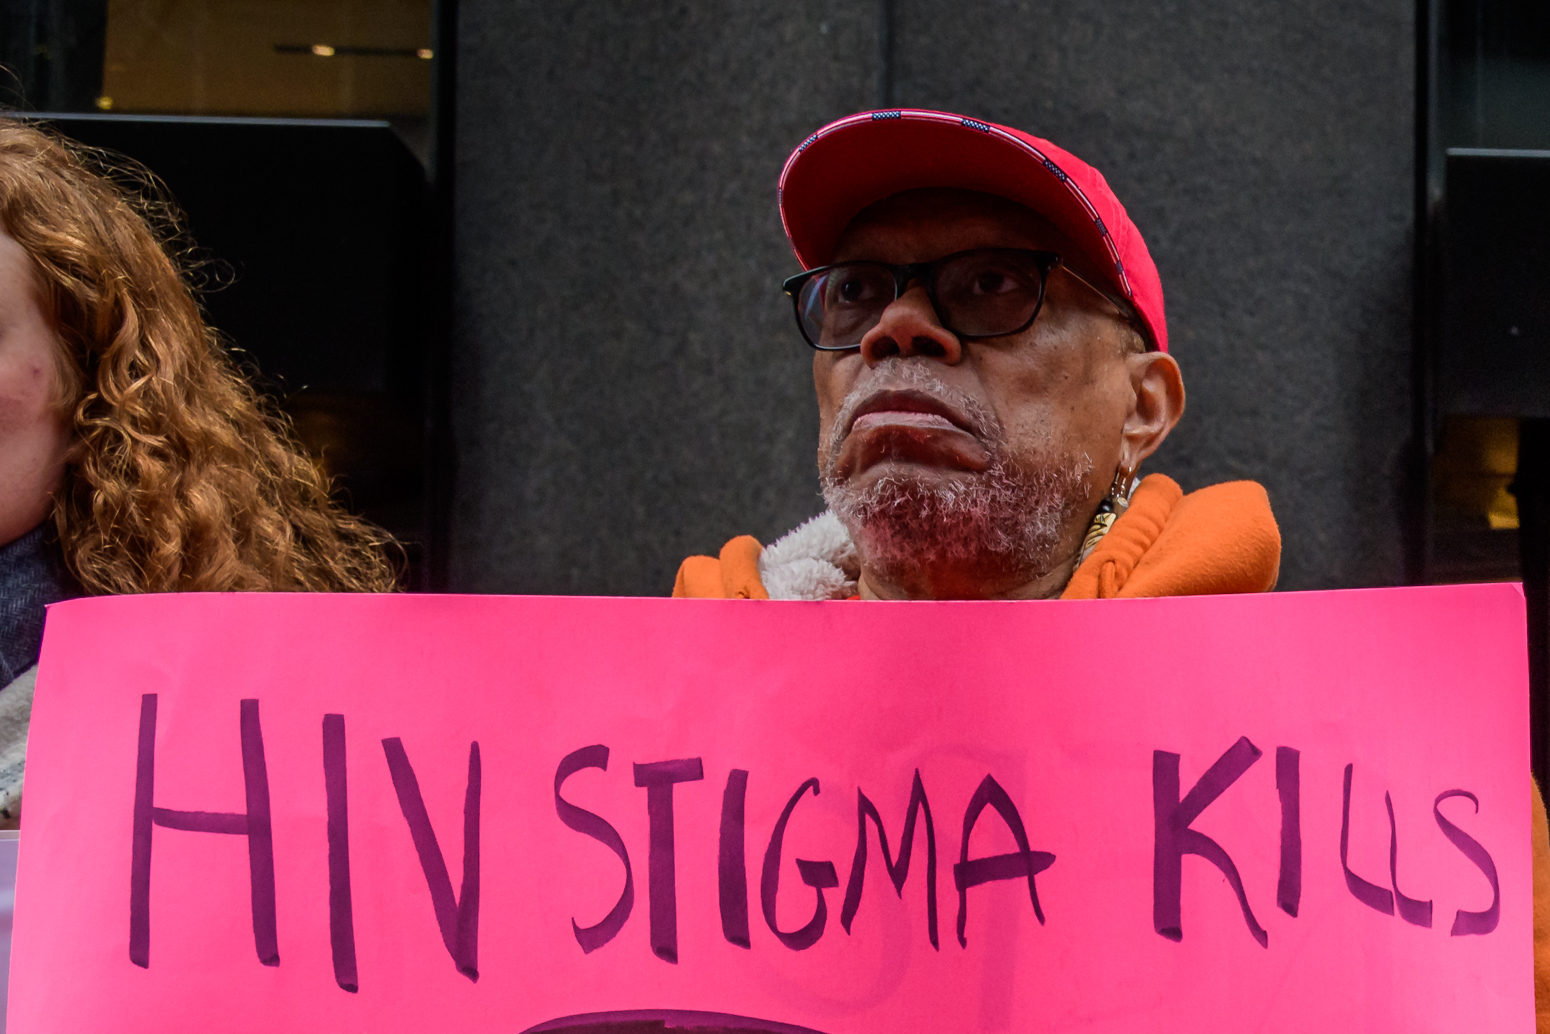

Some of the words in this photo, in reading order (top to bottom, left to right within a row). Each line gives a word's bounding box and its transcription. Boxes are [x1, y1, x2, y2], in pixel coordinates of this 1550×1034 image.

[129, 693, 482, 993] HIV
[553, 744, 1057, 964] STIGMA
[1152, 736, 1500, 948] KILLS
